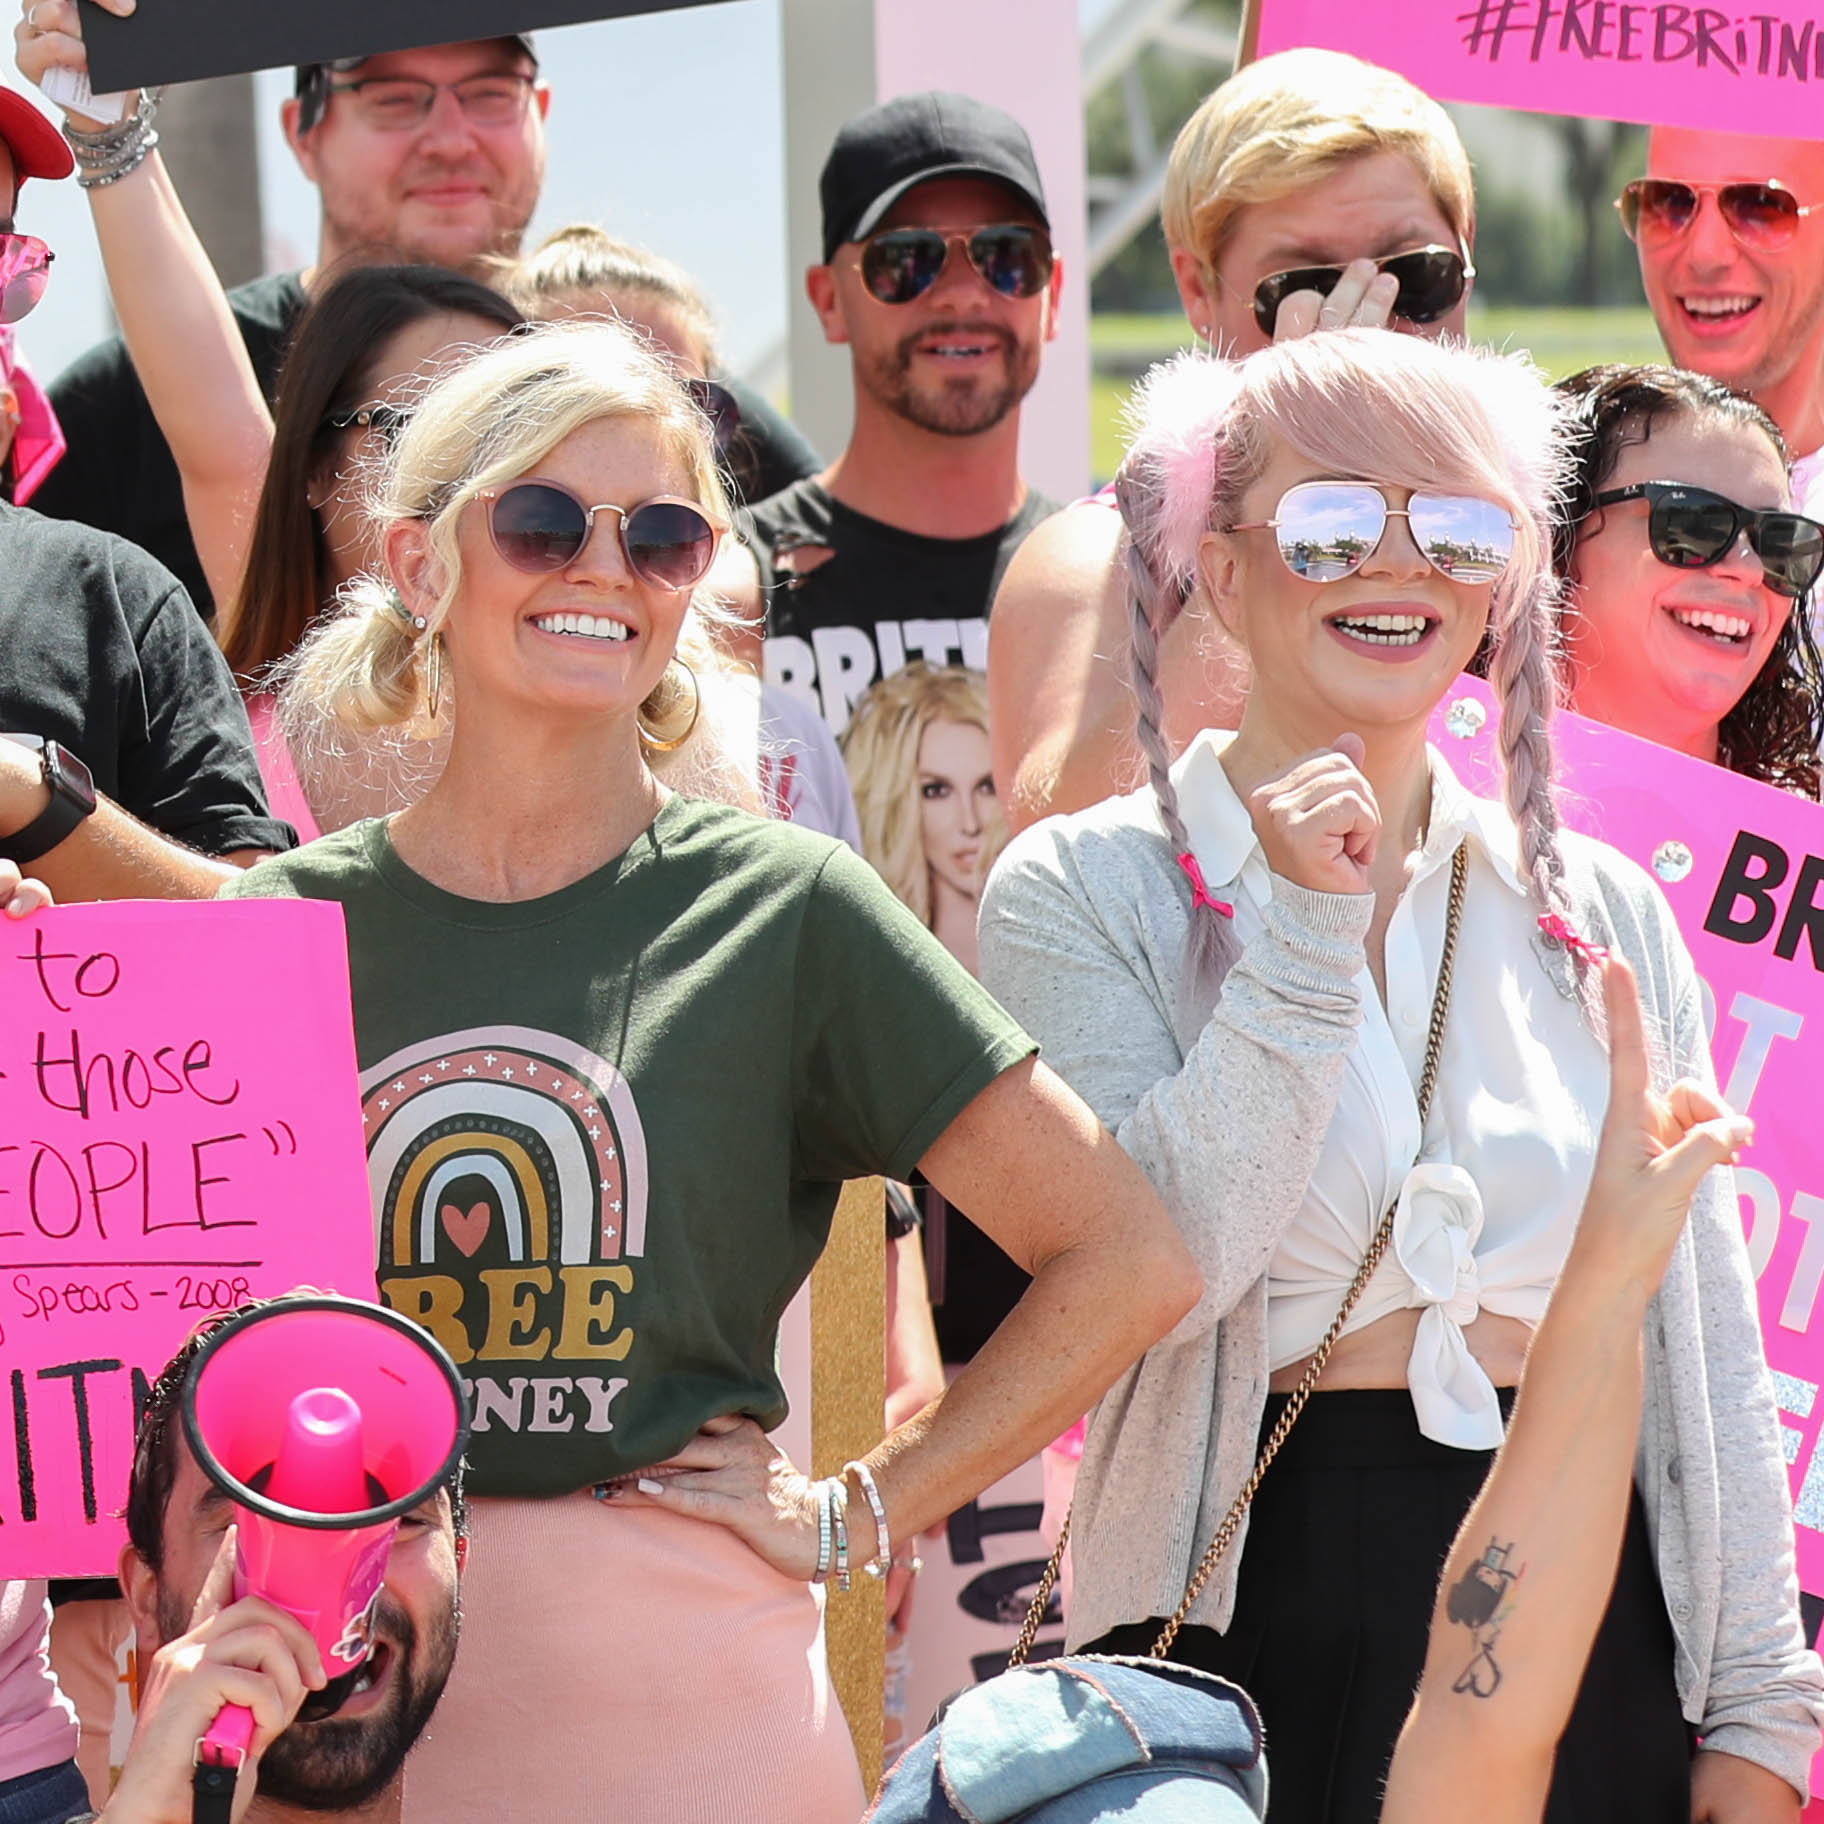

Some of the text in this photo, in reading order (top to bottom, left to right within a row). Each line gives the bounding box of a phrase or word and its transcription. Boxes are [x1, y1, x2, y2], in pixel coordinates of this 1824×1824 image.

[18, 929, 118, 1012] to
[31, 1029, 238, 1121] those
[13, 1274, 138, 1322] Spears
[381, 1265, 634, 1364] REE
